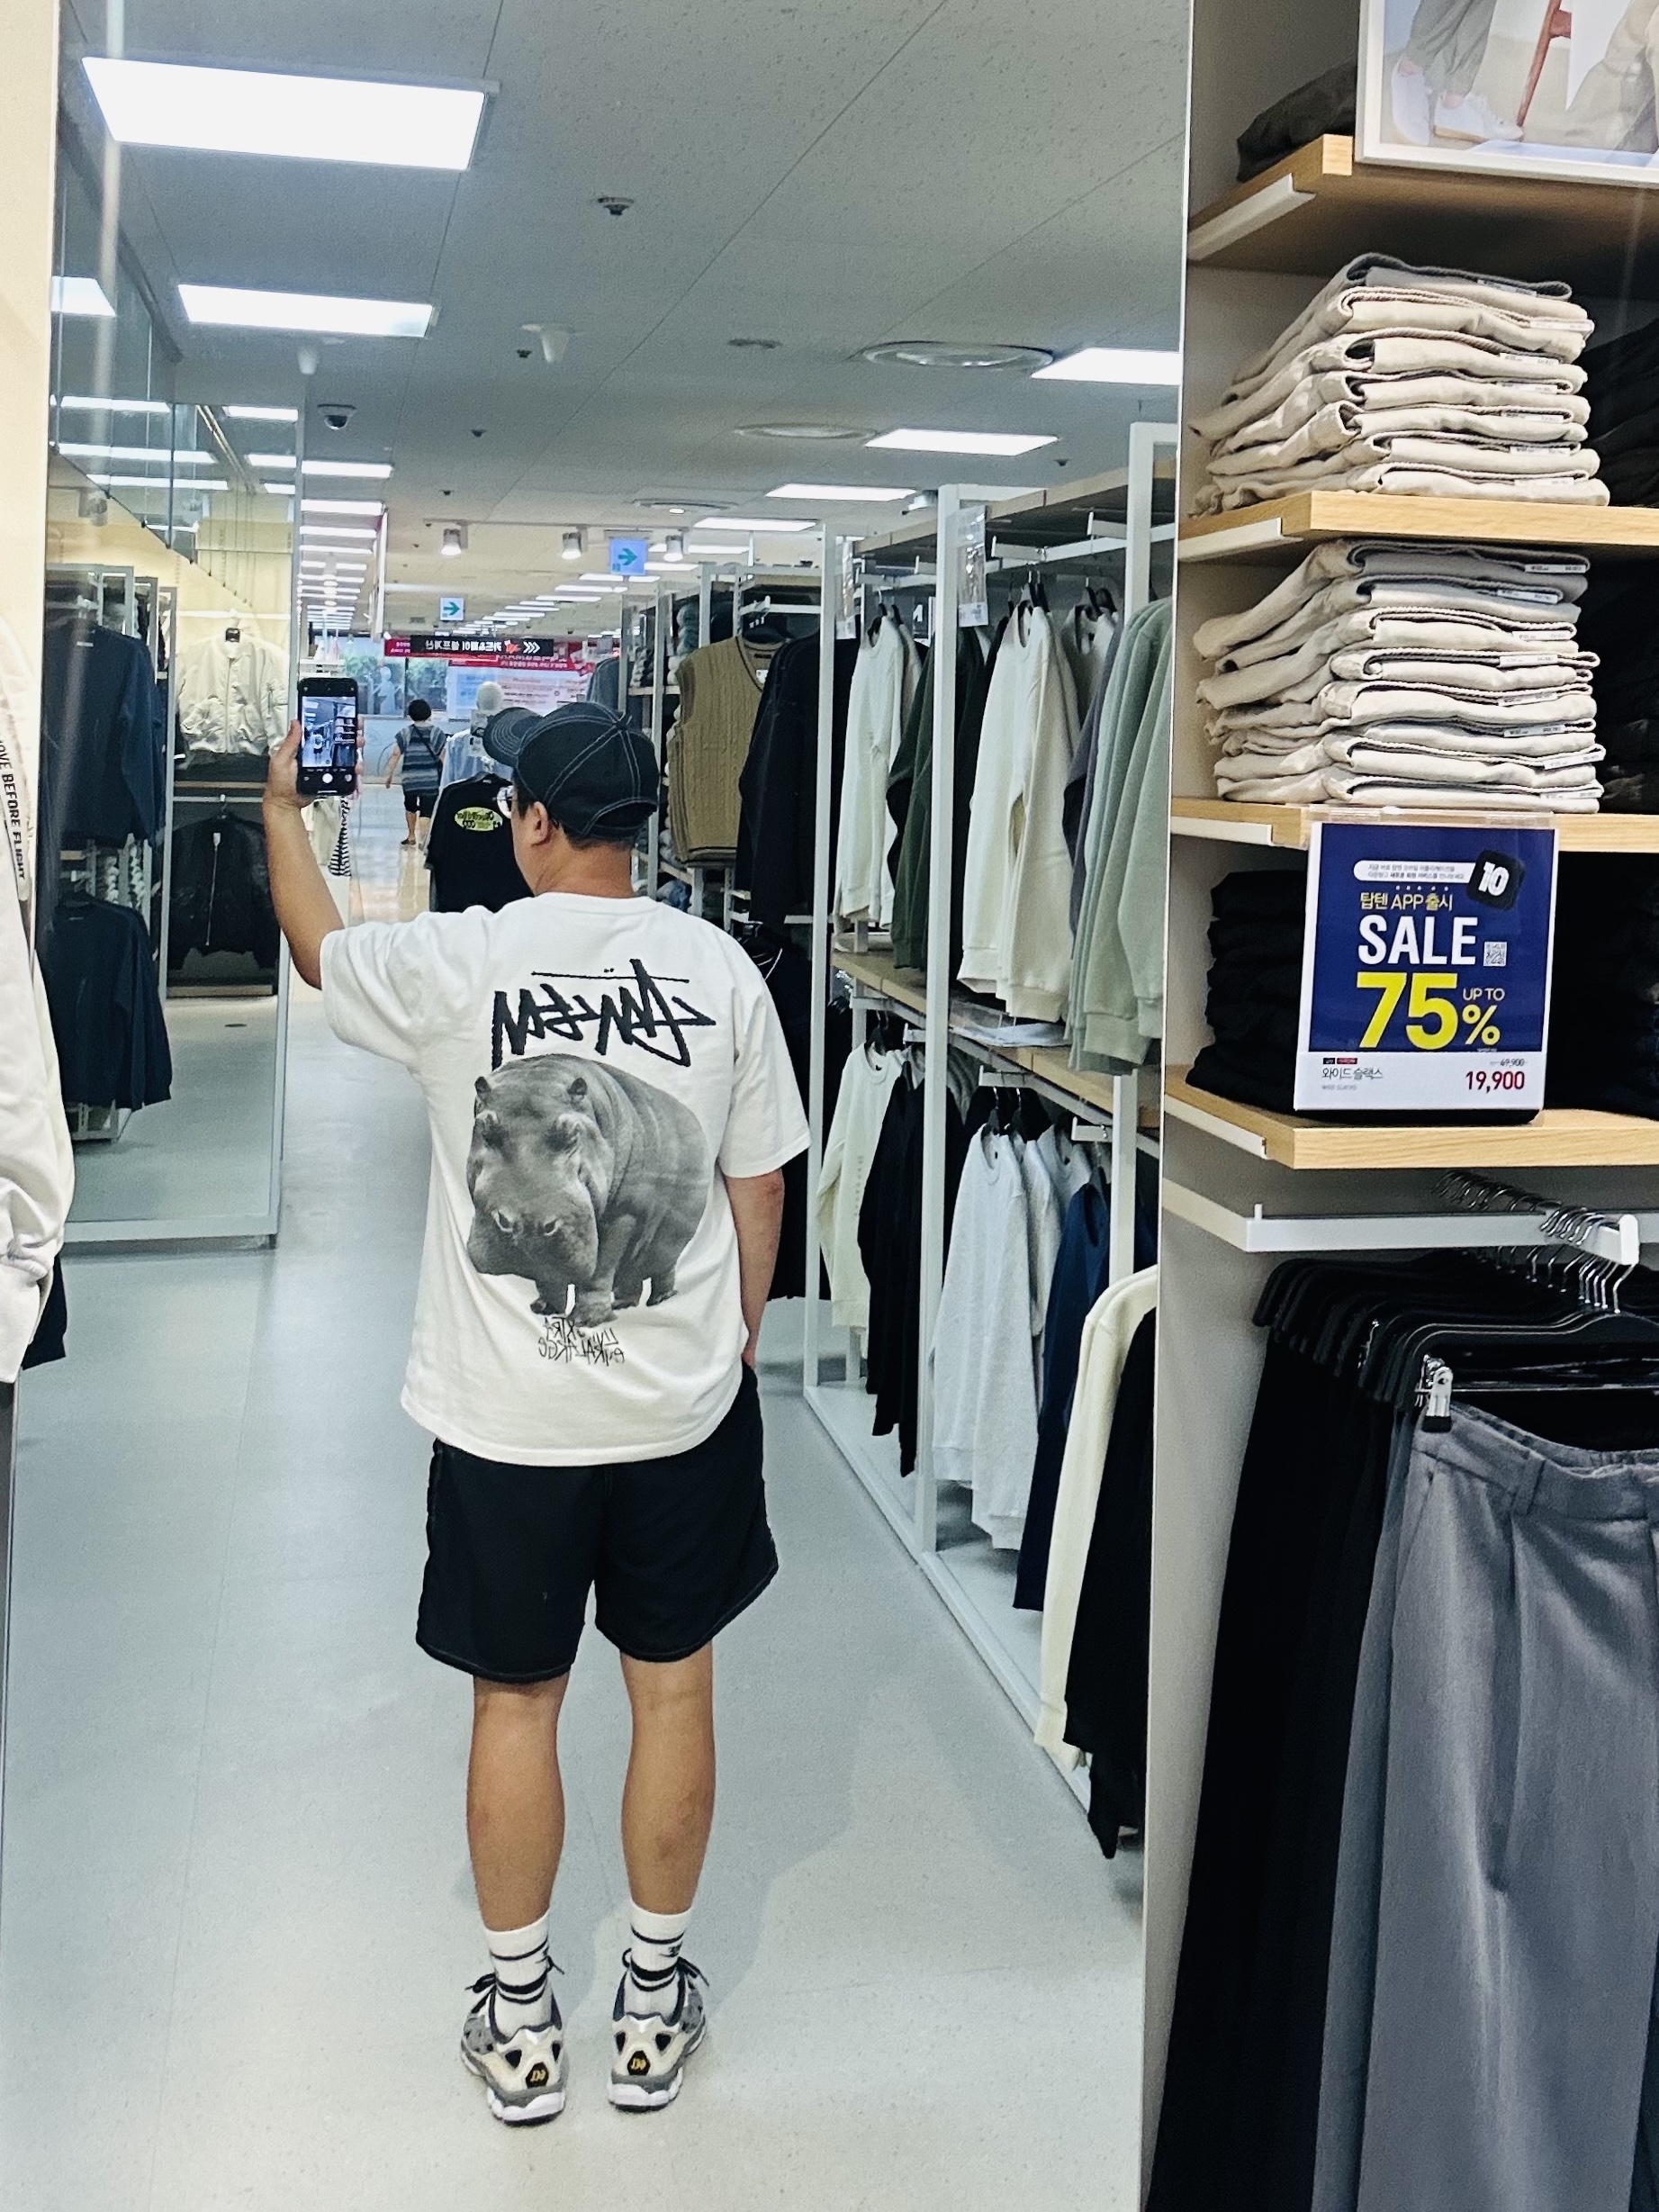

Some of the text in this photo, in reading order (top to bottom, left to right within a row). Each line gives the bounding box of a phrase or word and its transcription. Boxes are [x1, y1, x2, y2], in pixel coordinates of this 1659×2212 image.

[2, 773, 21, 827] BEFORE
[12, 830, 26, 880] FLIGHT
[1478, 861, 1510, 897] 10
[1360, 892, 1453, 911] 탑텐 APP 출시
[1357, 914, 1478, 966] SALE
[1462, 988, 1506, 1002] UP TO
[1321, 1067, 1384, 1080] 와이드 슬랙스
[1465, 1070, 1526, 1093] 19,900
